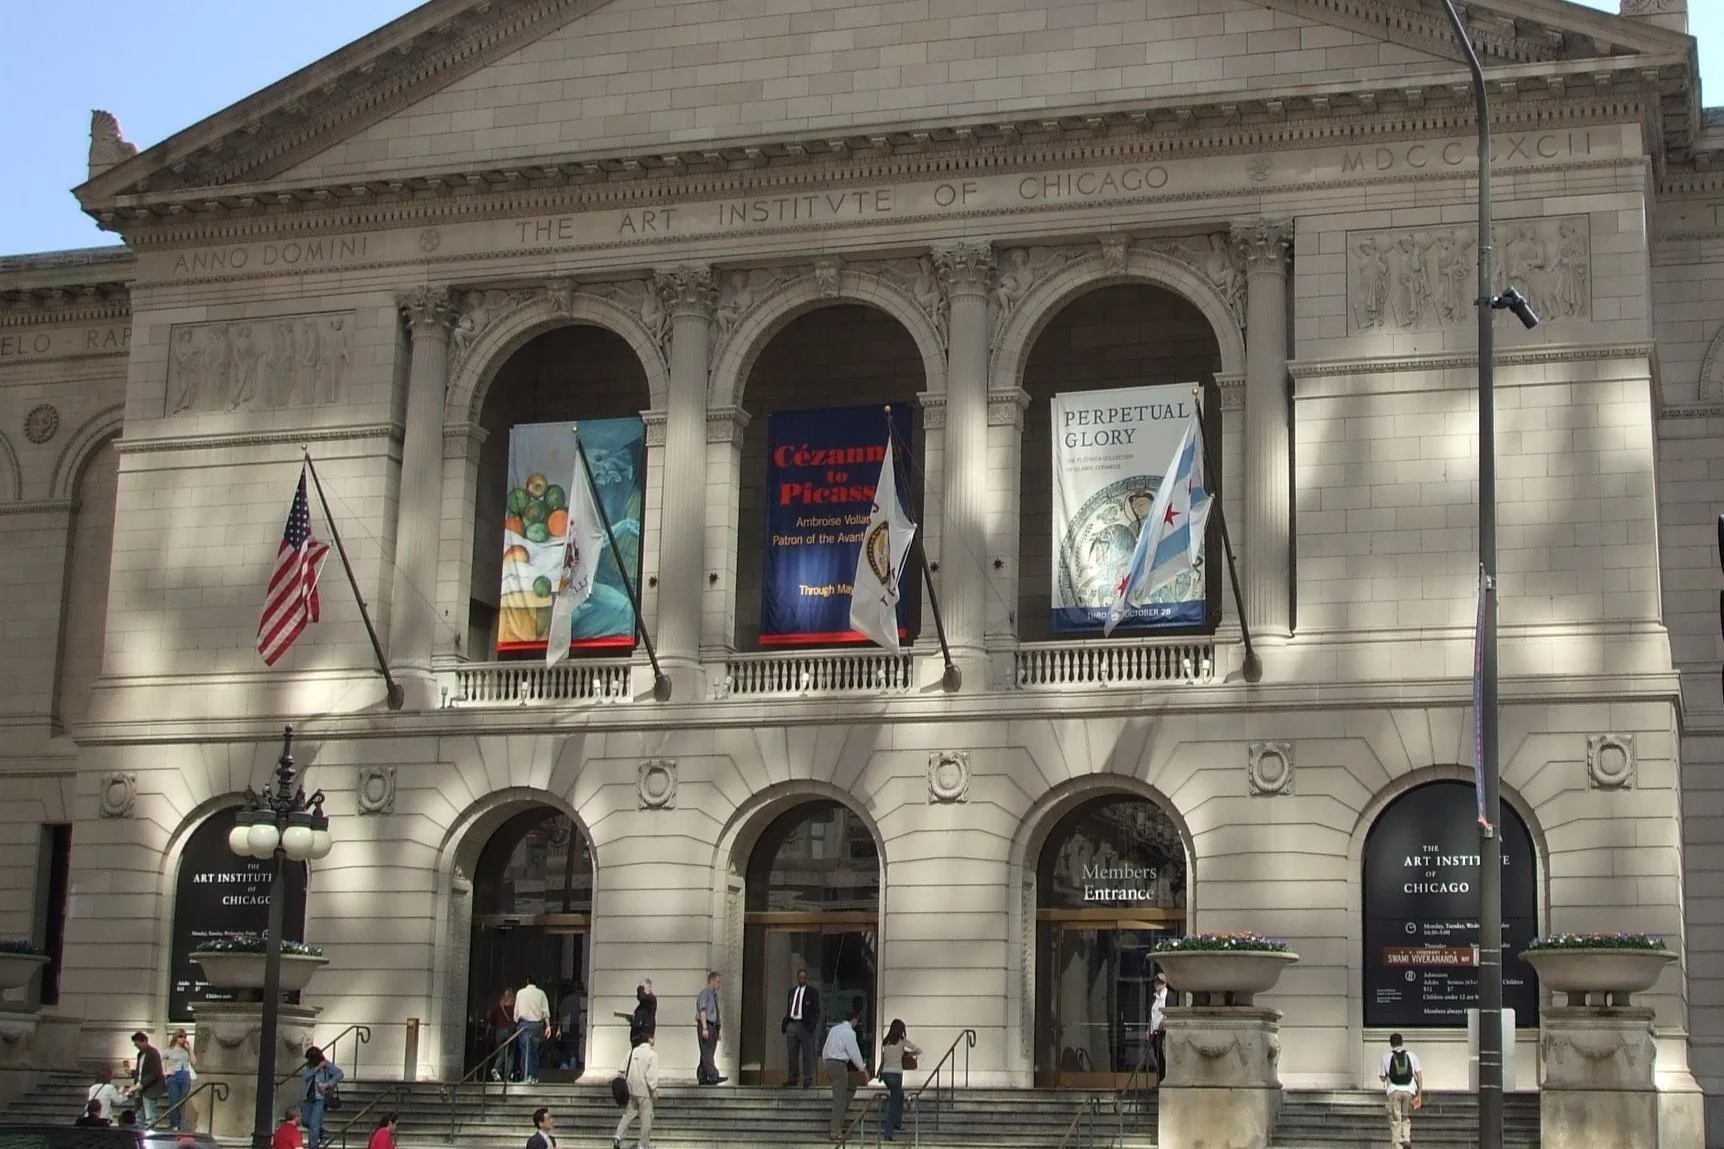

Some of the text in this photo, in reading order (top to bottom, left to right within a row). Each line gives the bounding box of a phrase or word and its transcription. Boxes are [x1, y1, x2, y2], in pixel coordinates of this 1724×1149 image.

[515, 166, 1169, 243] THE ART INSTITVTE OF CHICAGO
[173, 236, 369, 275] ANNO DOMINI
[1064, 402, 1191, 427] PERPETUAL
[1064, 428, 1137, 449] GLORY
[774, 443, 886, 468] Cézann
[827, 470, 849, 484] to
[780, 482, 876, 506] Picass
[796, 514, 872, 527] Ambroise Vollar
[773, 535, 803, 546] Patron
[806, 534, 815, 545] of
[819, 533, 835, 544] the
[799, 584, 835, 597] Through
[1404, 856, 1431, 866] ART
[193, 873, 215, 883] ART
[1082, 863, 1157, 880] Members
[1084, 884, 1155, 901] Entrance
[1403, 882, 1470, 893] CHICAGO
[1388, 954, 1409, 964] SWAMI
[1411, 954, 1458, 964] VIVEKANANDA
